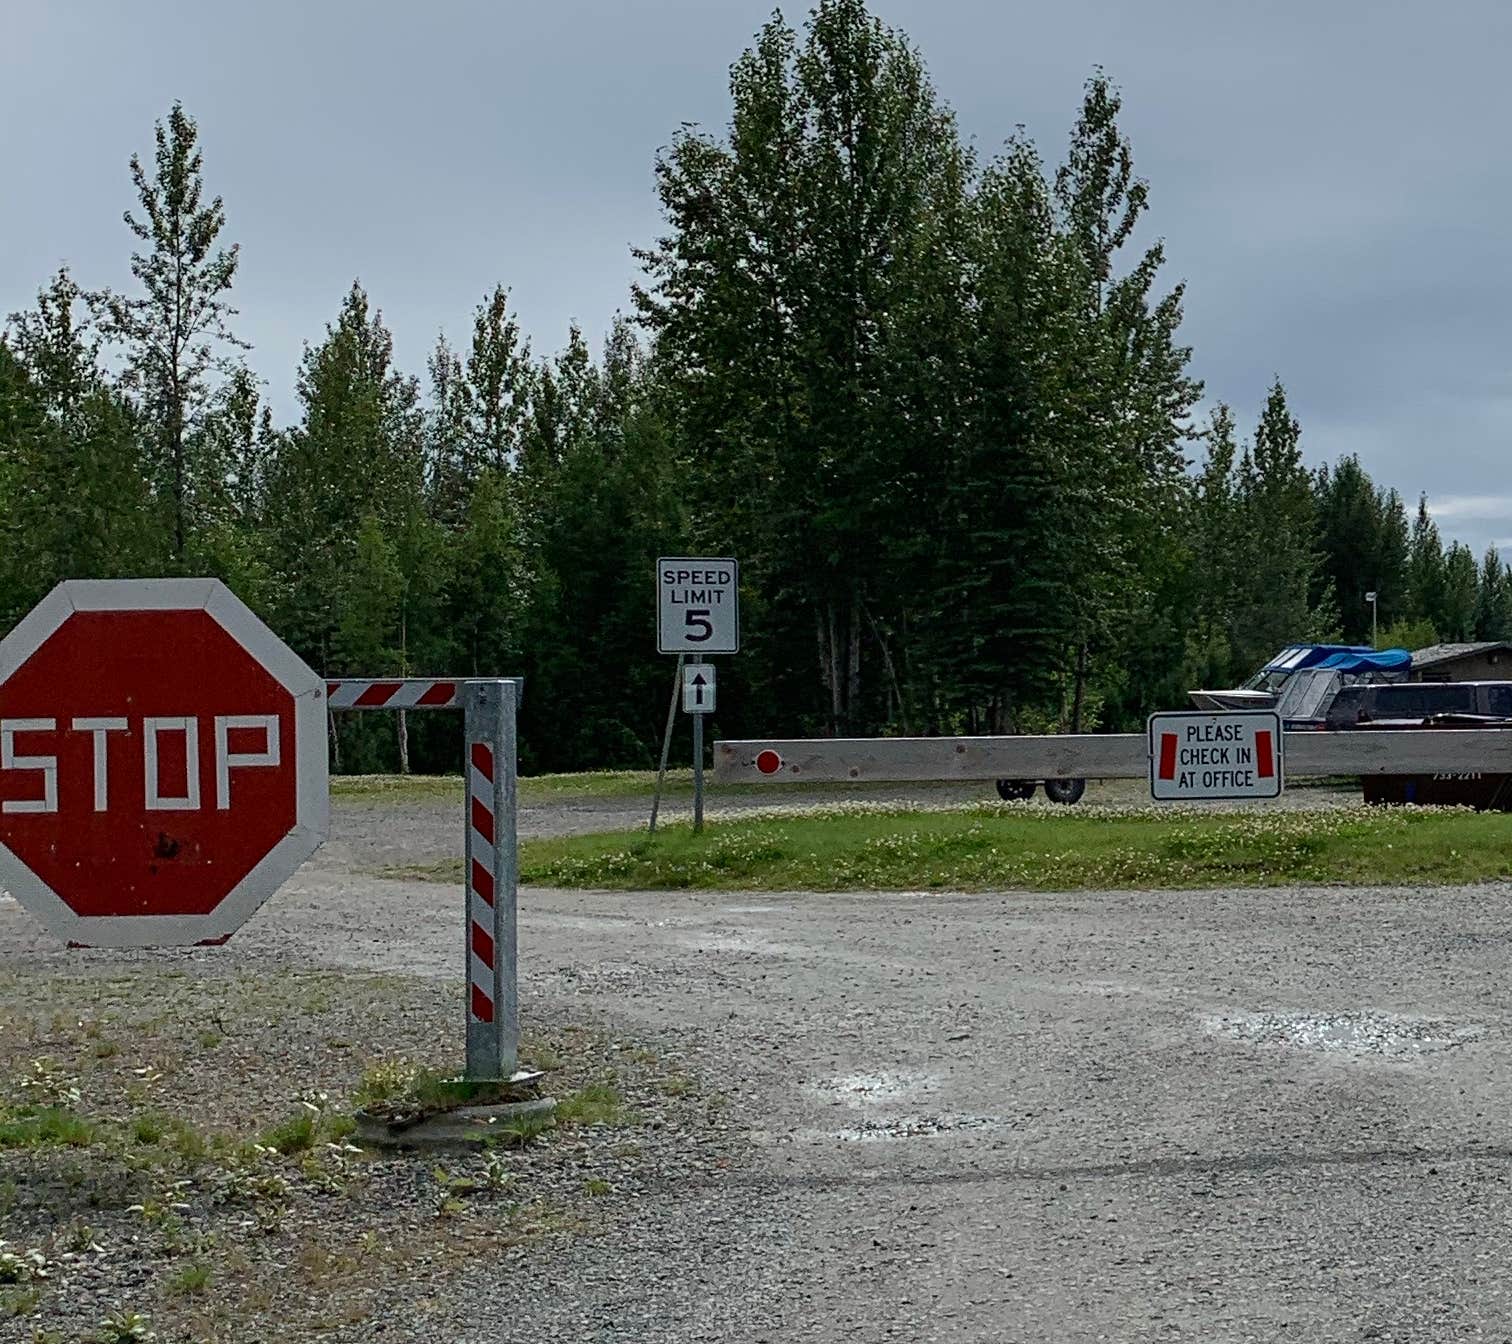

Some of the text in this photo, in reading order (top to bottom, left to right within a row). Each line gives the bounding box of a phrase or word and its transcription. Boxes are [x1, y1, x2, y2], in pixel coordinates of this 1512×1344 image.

[663, 570, 731, 585] SPEED
[671, 590, 724, 604] LIMIT
[684, 609, 713, 642] 5
[1187, 725, 1243, 742] PLEASE
[0, 714, 280, 813] STOP
[1180, 747, 1251, 765] CHECK IN
[1178, 770, 1254, 788] AT OFFICE
